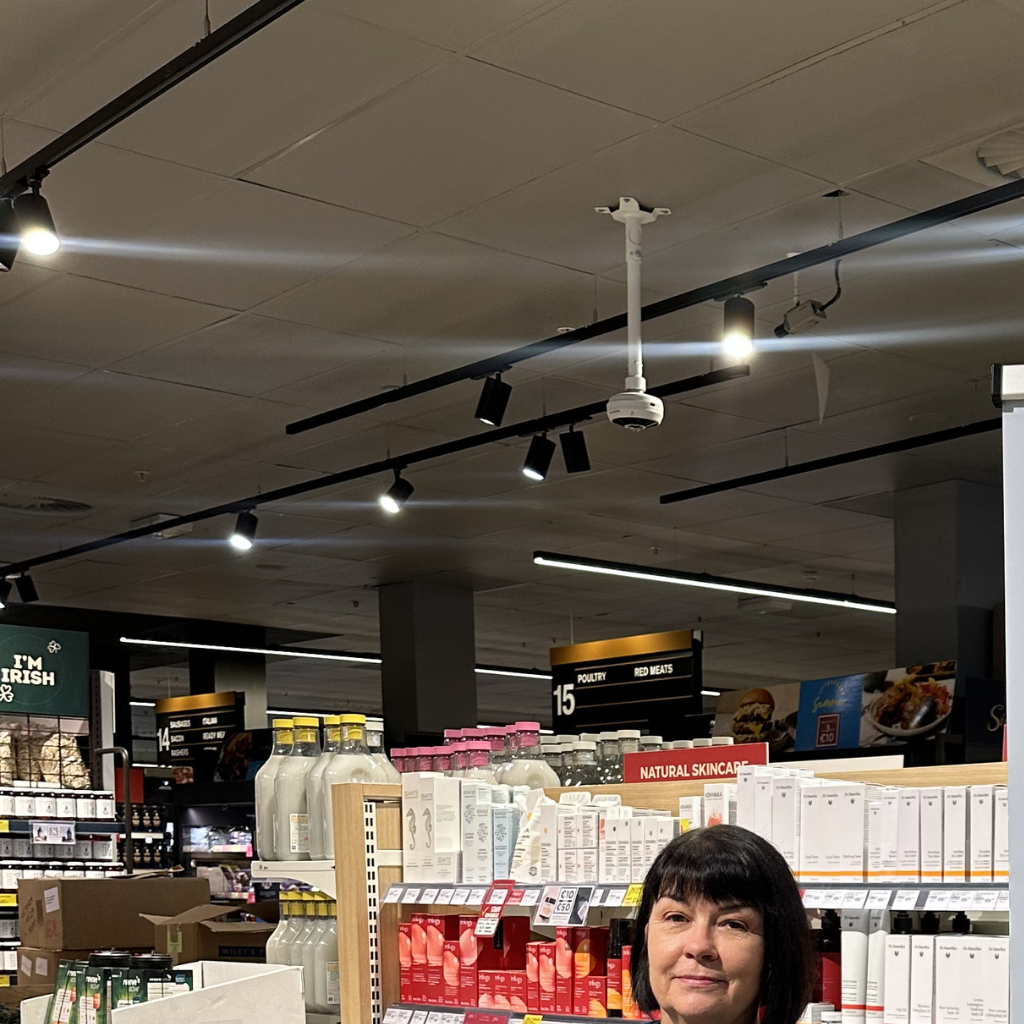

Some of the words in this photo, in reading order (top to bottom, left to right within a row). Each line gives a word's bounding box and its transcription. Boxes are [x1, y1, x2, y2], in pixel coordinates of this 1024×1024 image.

[13, 654, 43, 671] I'M
[1, 669, 55, 687] IRISH
[577, 672, 607, 683] POULTRY
[634, 667, 648, 677] RED
[650, 664, 673, 676] MEATS
[553, 683, 576, 715] 15
[157, 727, 171, 752] 14
[640, 763, 691, 779] NATURAL
